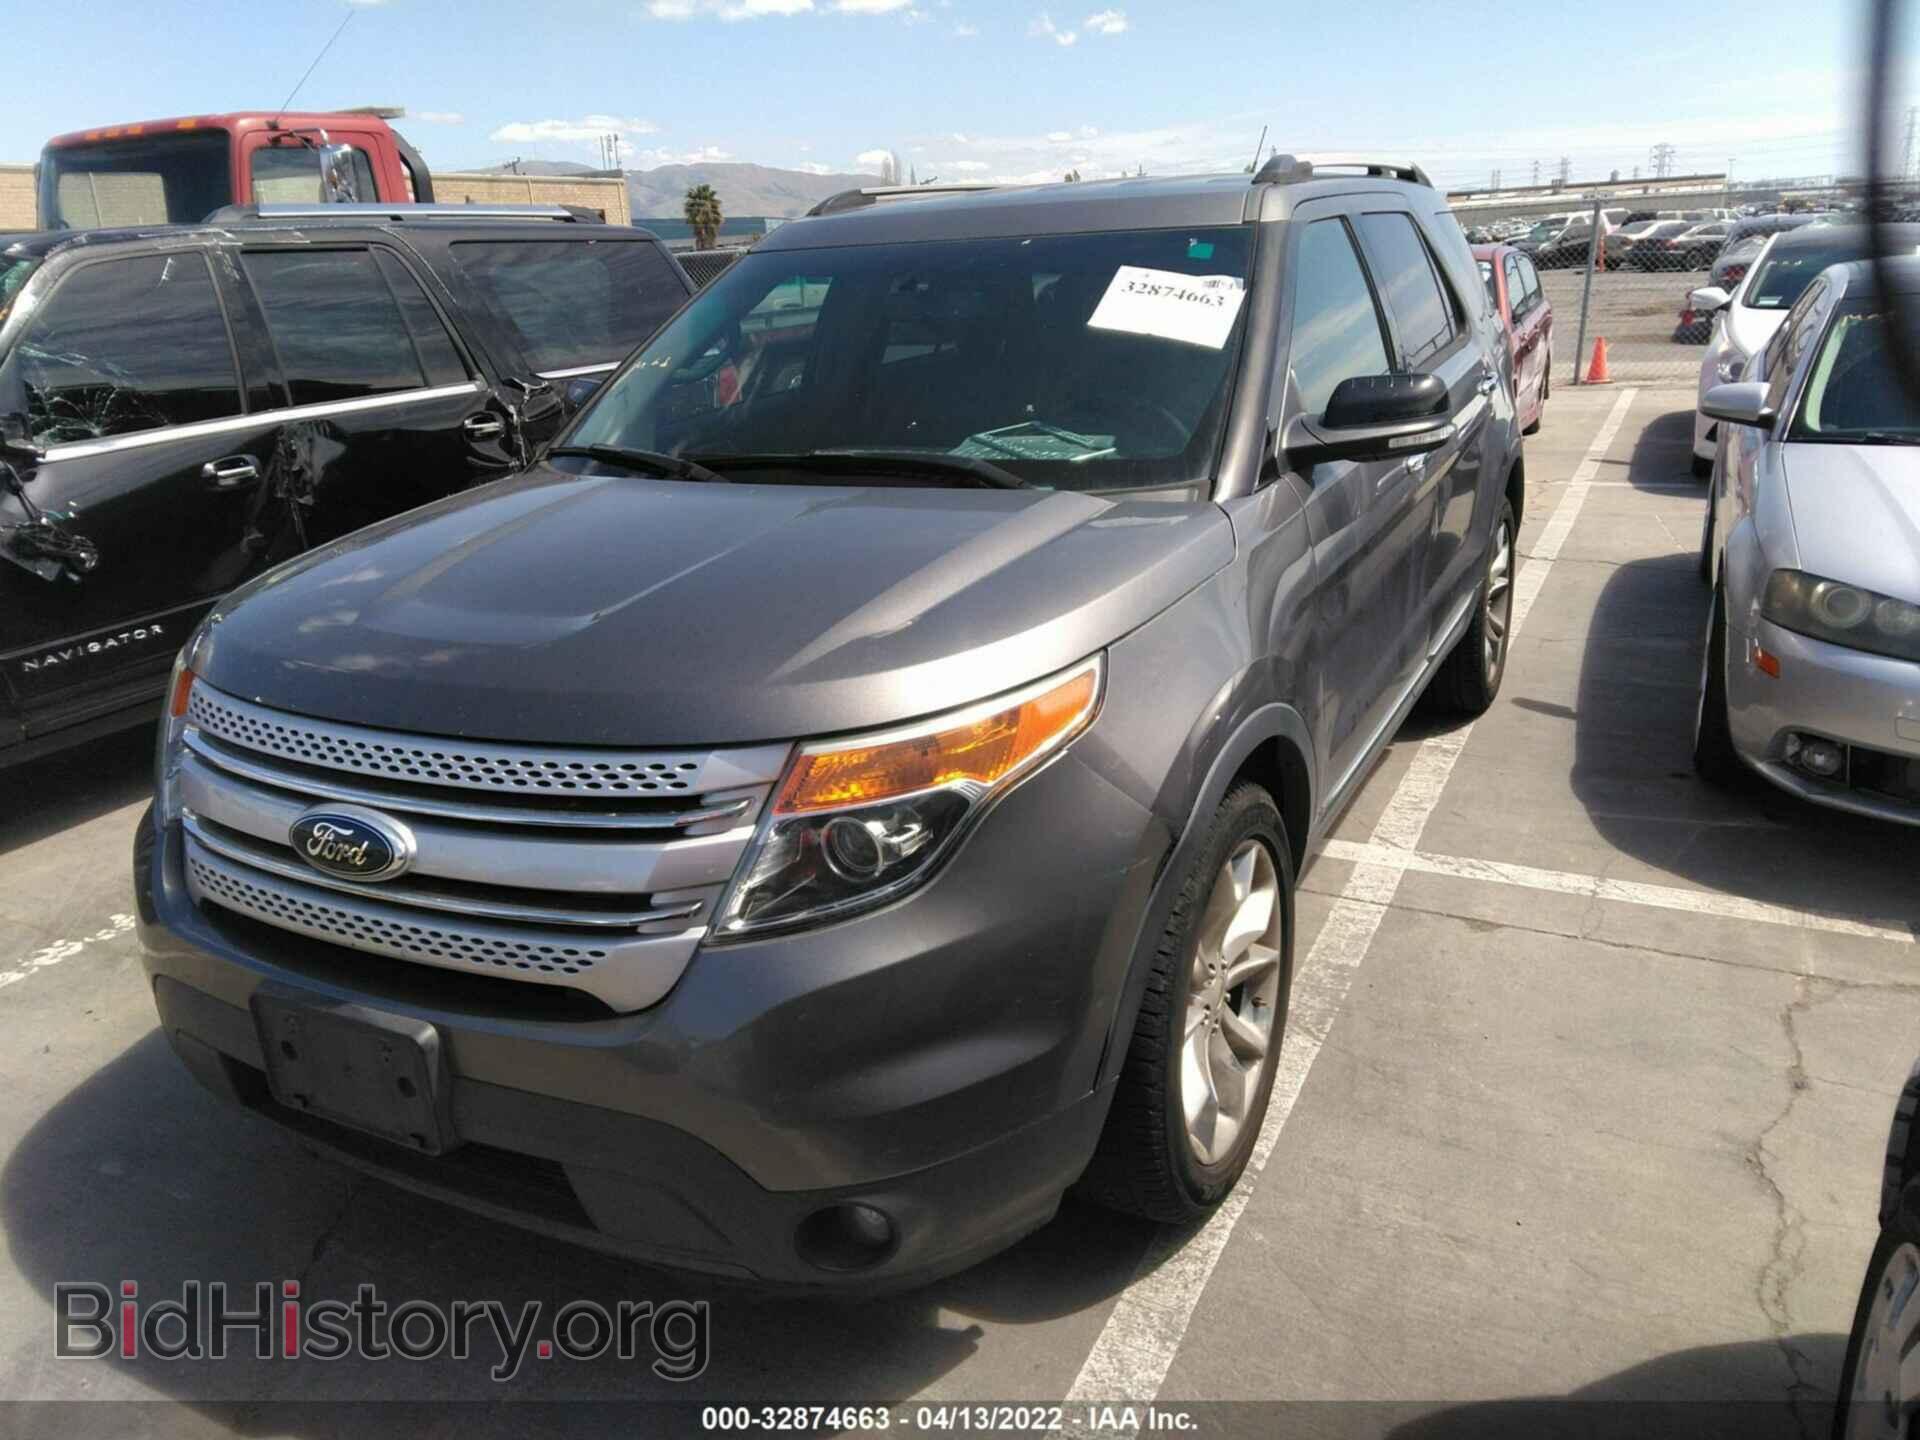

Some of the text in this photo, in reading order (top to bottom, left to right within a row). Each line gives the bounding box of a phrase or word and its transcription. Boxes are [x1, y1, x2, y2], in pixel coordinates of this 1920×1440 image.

[1120, 281, 1225, 307] 32874663
[23, 624, 164, 673] NAVIGATOR
[306, 822, 369, 866] Ford
